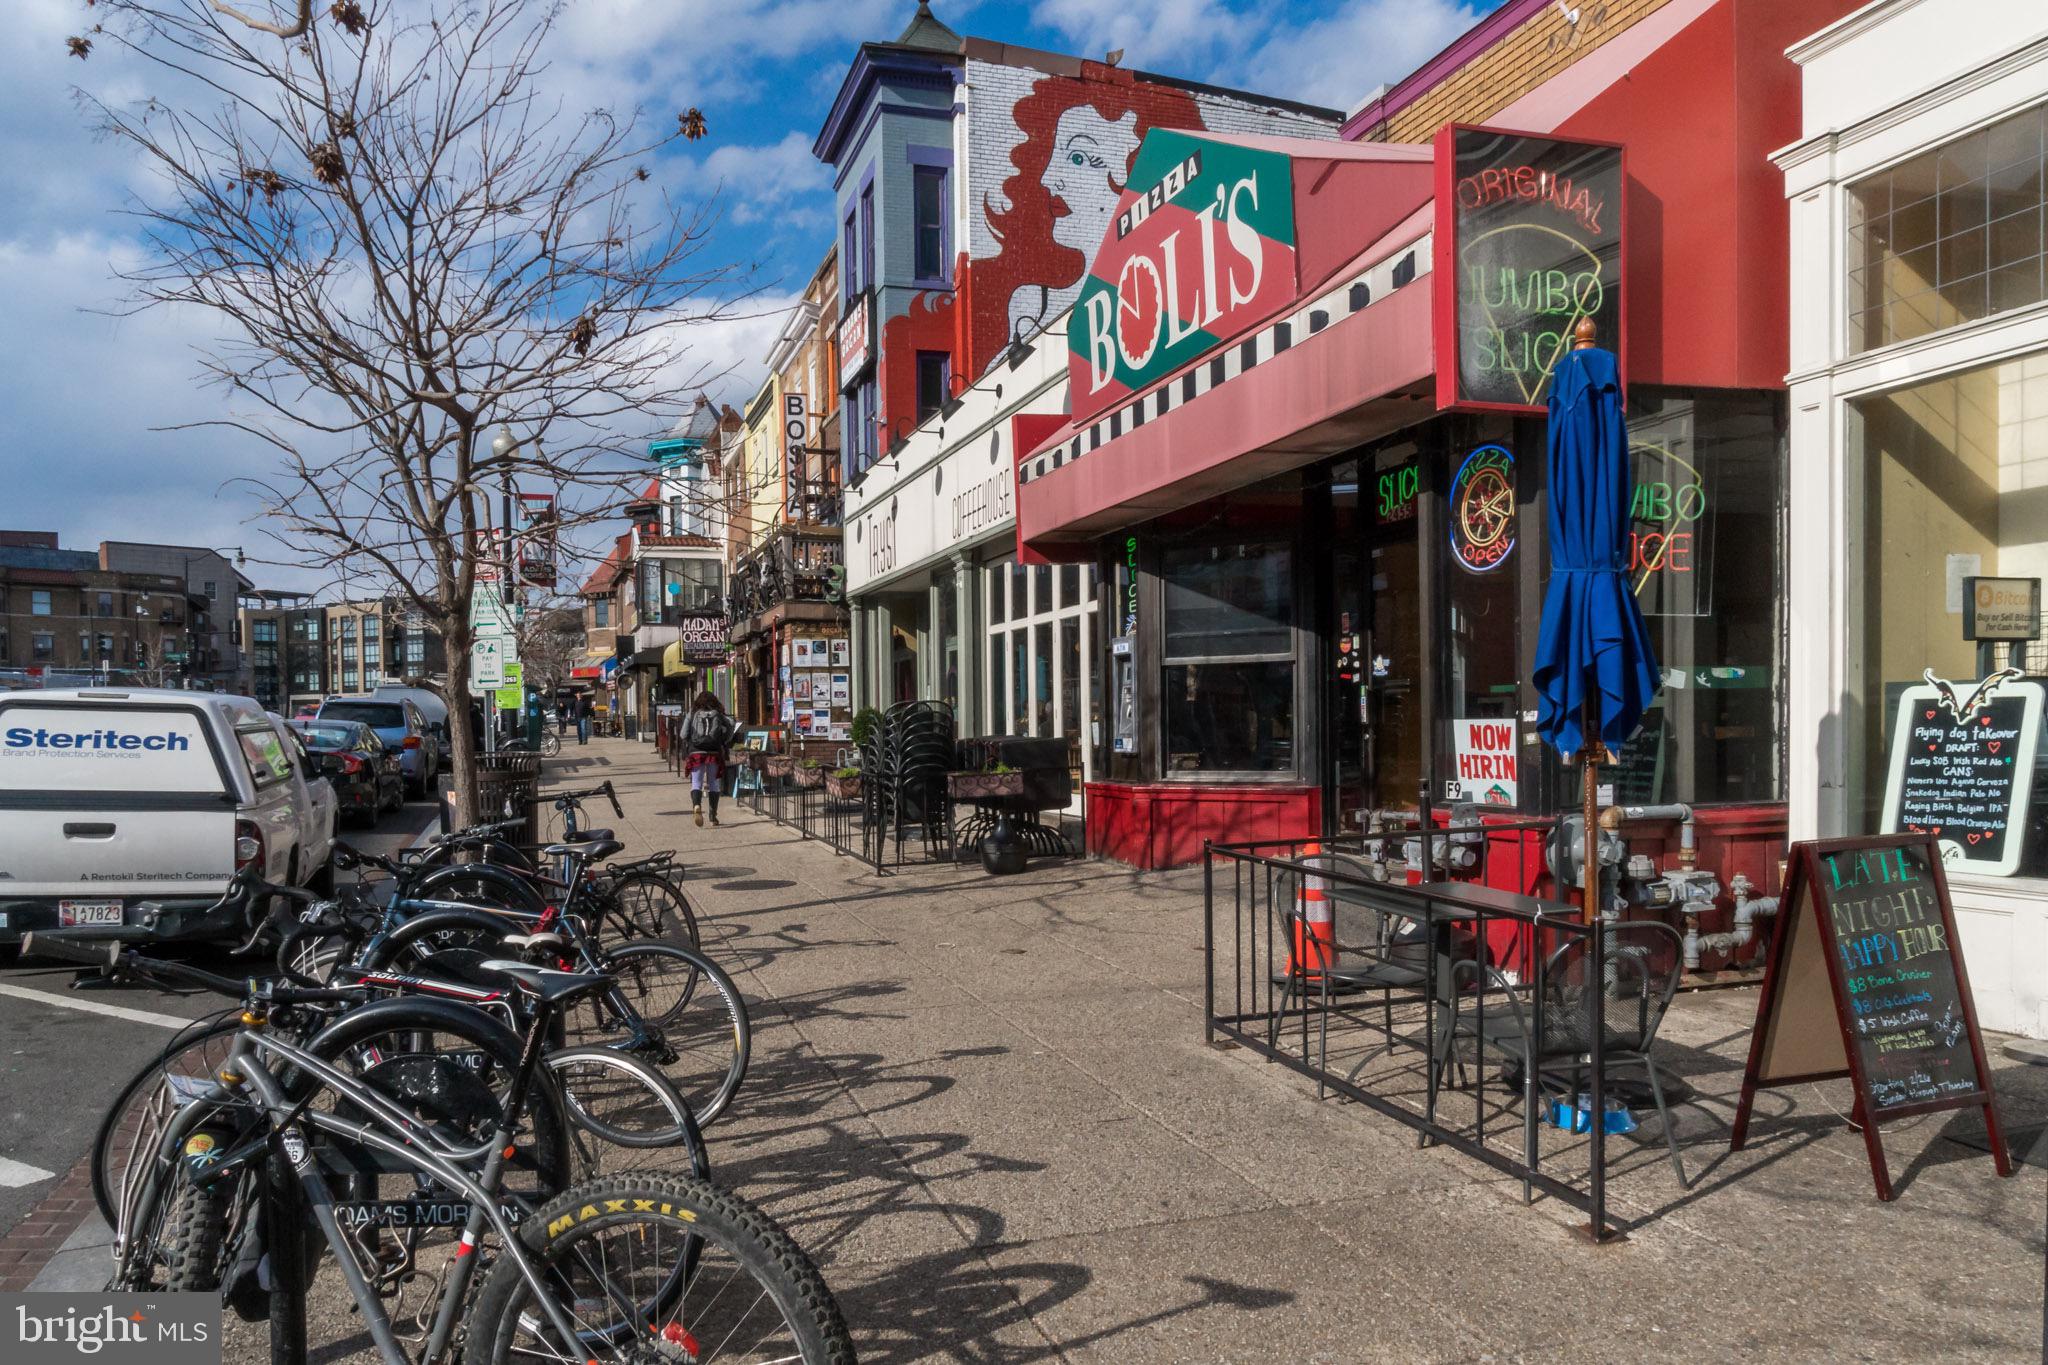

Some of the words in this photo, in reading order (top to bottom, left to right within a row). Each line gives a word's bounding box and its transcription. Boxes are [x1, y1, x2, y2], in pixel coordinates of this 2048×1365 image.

[1119, 155, 1199, 238] PIZZA
[1458, 165, 1603, 234] ORIGINAL
[1084, 170, 1263, 395] BOLI'S
[1464, 265, 1603, 316] JUMBO
[1473, 328, 1577, 376] SLIC
[1460, 449, 1509, 488] PIZZA
[952, 467, 1011, 540] COFFEEHOUSE
[867, 500, 897, 578] TRYST
[1463, 535, 1508, 565] OPEN
[1630, 533, 1692, 571] ICE
[1126, 537, 1137, 613] SLICE
[2001, 613, 2013, 621] Sell
[683, 631, 725, 642] ORGAN
[5, 728, 188, 750] Steritech
[1469, 724, 1512, 751] NOW
[1915, 727, 1944, 742] Flying
[1949, 727, 1968, 741] dog
[39, 750, 93, 758] Protection
[96, 750, 141, 759] Services
[1945, 743, 1980, 753] DRAFT:
[1933, 757, 1949, 765] SOB
[1953, 757, 1970, 765] Irish
[1973, 757, 1987, 765] Red
[1990, 757, 2003, 766] Ale
[1943, 767, 1974, 776] CANS:
[1447, 782, 1461, 798] F9
[1943, 789, 1967, 798] Indian
[1970, 789, 1986, 798] Pale
[1988, 789, 2001, 797] Ale
[1905, 801, 1930, 812] Raging
[1933, 803, 1954, 811] Bitch
[1957, 804, 1985, 814] Belgian
[1989, 803, 2003, 812] IPA
[1946, 817, 1966, 826] Blood
[1966, 818, 1991, 829] Orange
[1992, 820, 2006, 829] Ale
[80, 873, 88, 881] A
[91, 873, 134, 881] Rentokil
[137, 872, 183, 880] Steritech
[185, 872, 233, 882] Company
[1826, 848, 1919, 891] LATE
[1832, 887, 1925, 937] NIGHT
[1897, 924, 1949, 960] HOUR
[1867, 975, 1895, 988] Bone
[1880, 1014, 1901, 1027] Irish
[1901, 1009, 1930, 1024] Coffee
[338, 1204, 408, 1226] DAMS
[548, 1199, 697, 1239] MAXXIS
